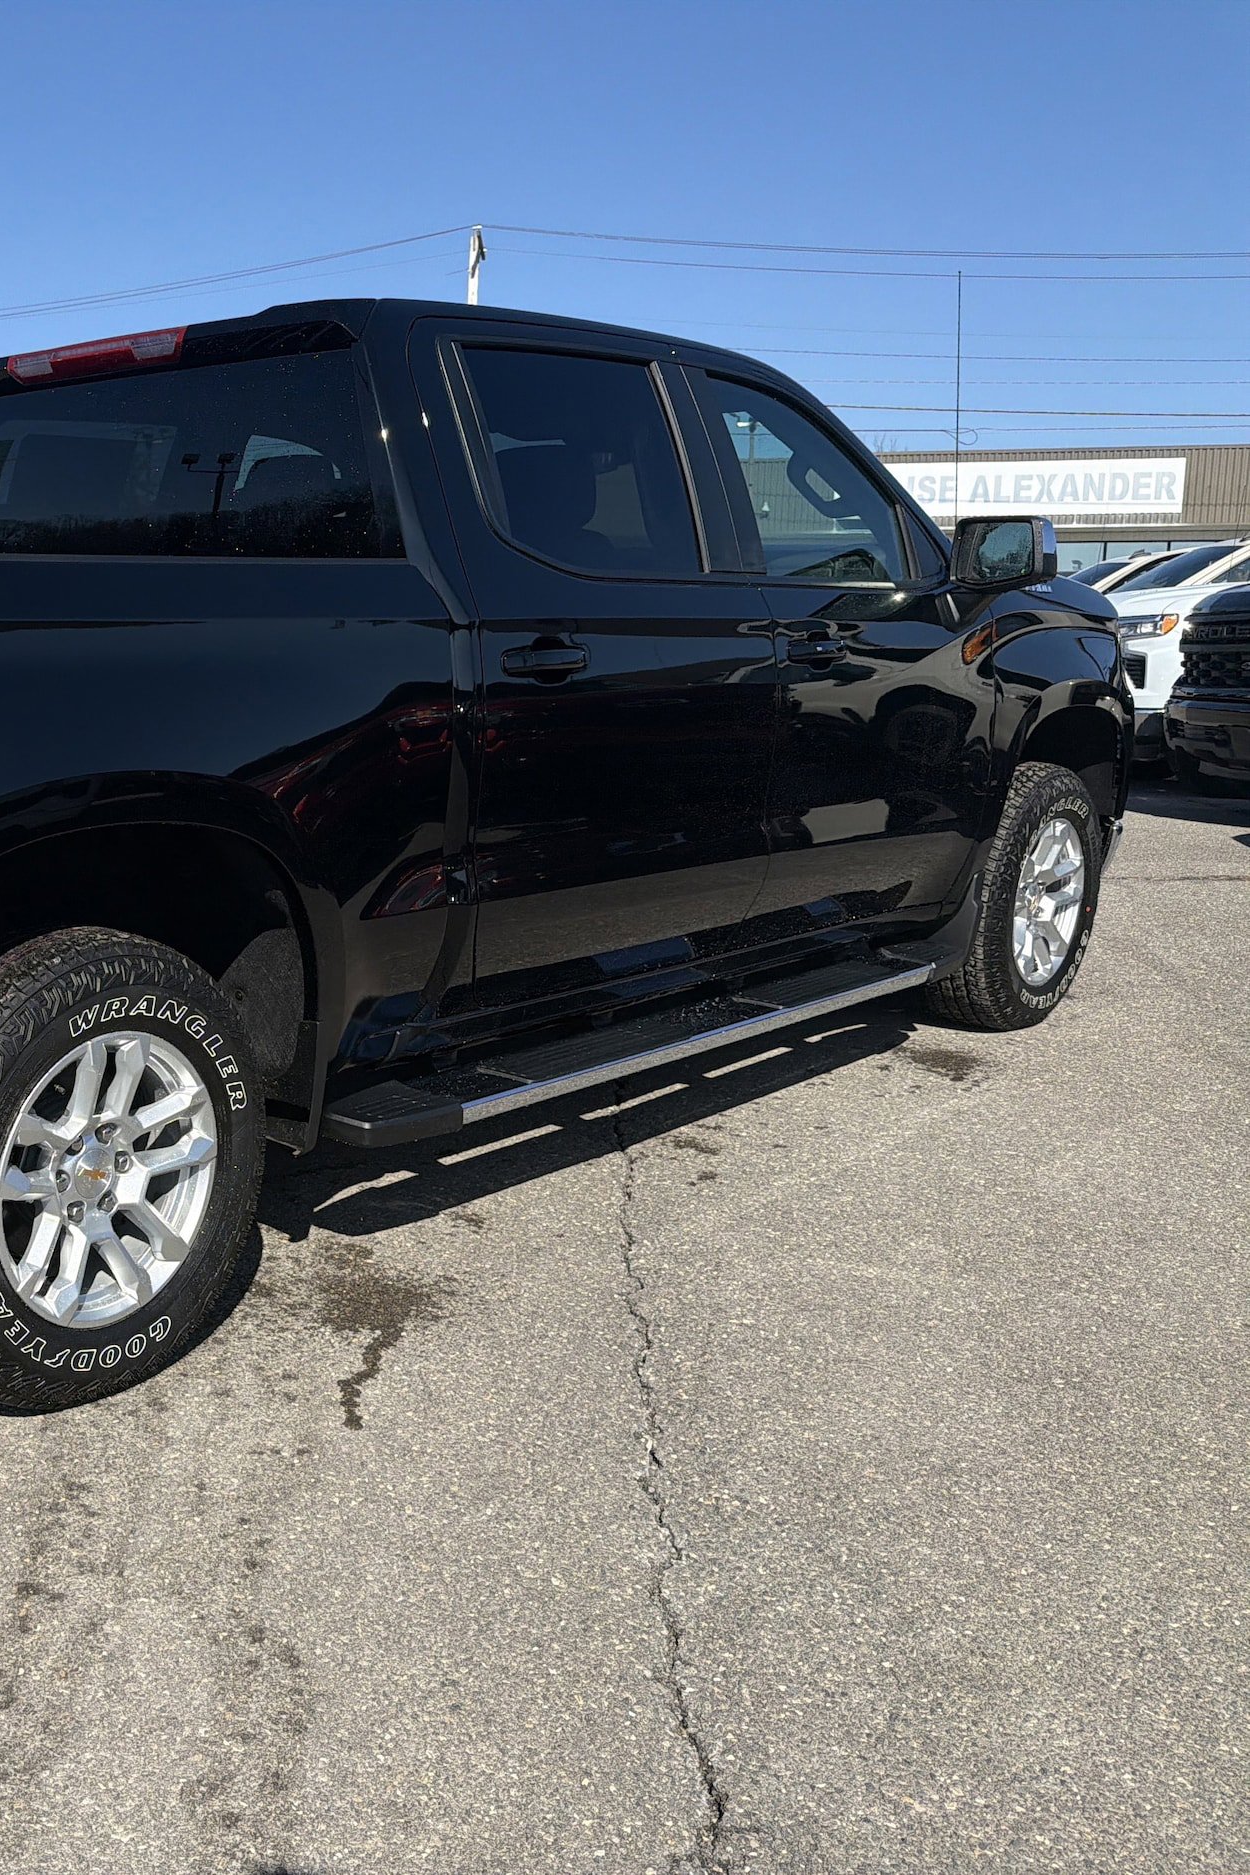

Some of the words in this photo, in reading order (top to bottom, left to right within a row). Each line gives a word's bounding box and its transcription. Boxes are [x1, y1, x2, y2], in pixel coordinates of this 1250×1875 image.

[968, 471, 1177, 503] ALEXANDER
[1019, 929, 1089, 1010] GOODYEAR
[69, 995, 247, 1111] WRANGLER
